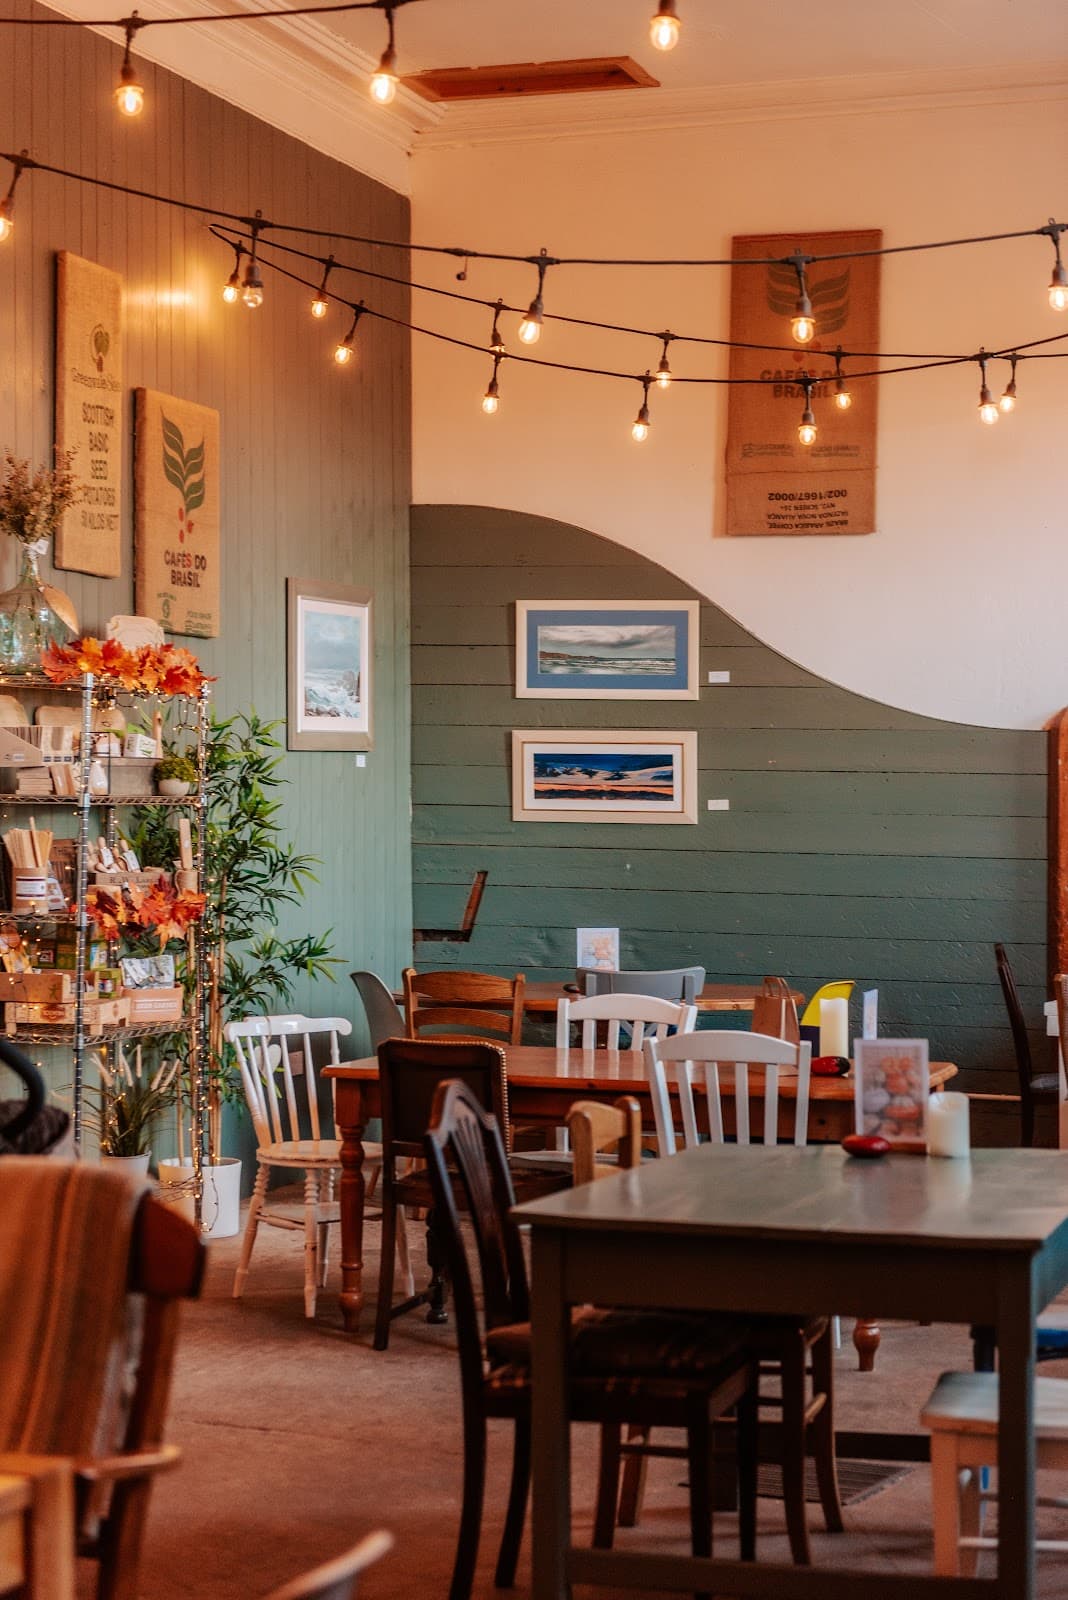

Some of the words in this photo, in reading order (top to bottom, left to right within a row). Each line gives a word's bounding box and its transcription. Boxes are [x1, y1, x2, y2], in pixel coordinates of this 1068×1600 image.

[773, 383, 832, 399] BRASIL
[90, 458, 108, 480] SEED
[194, 554, 207, 571] DO
[171, 569, 201, 588] BRASIL
